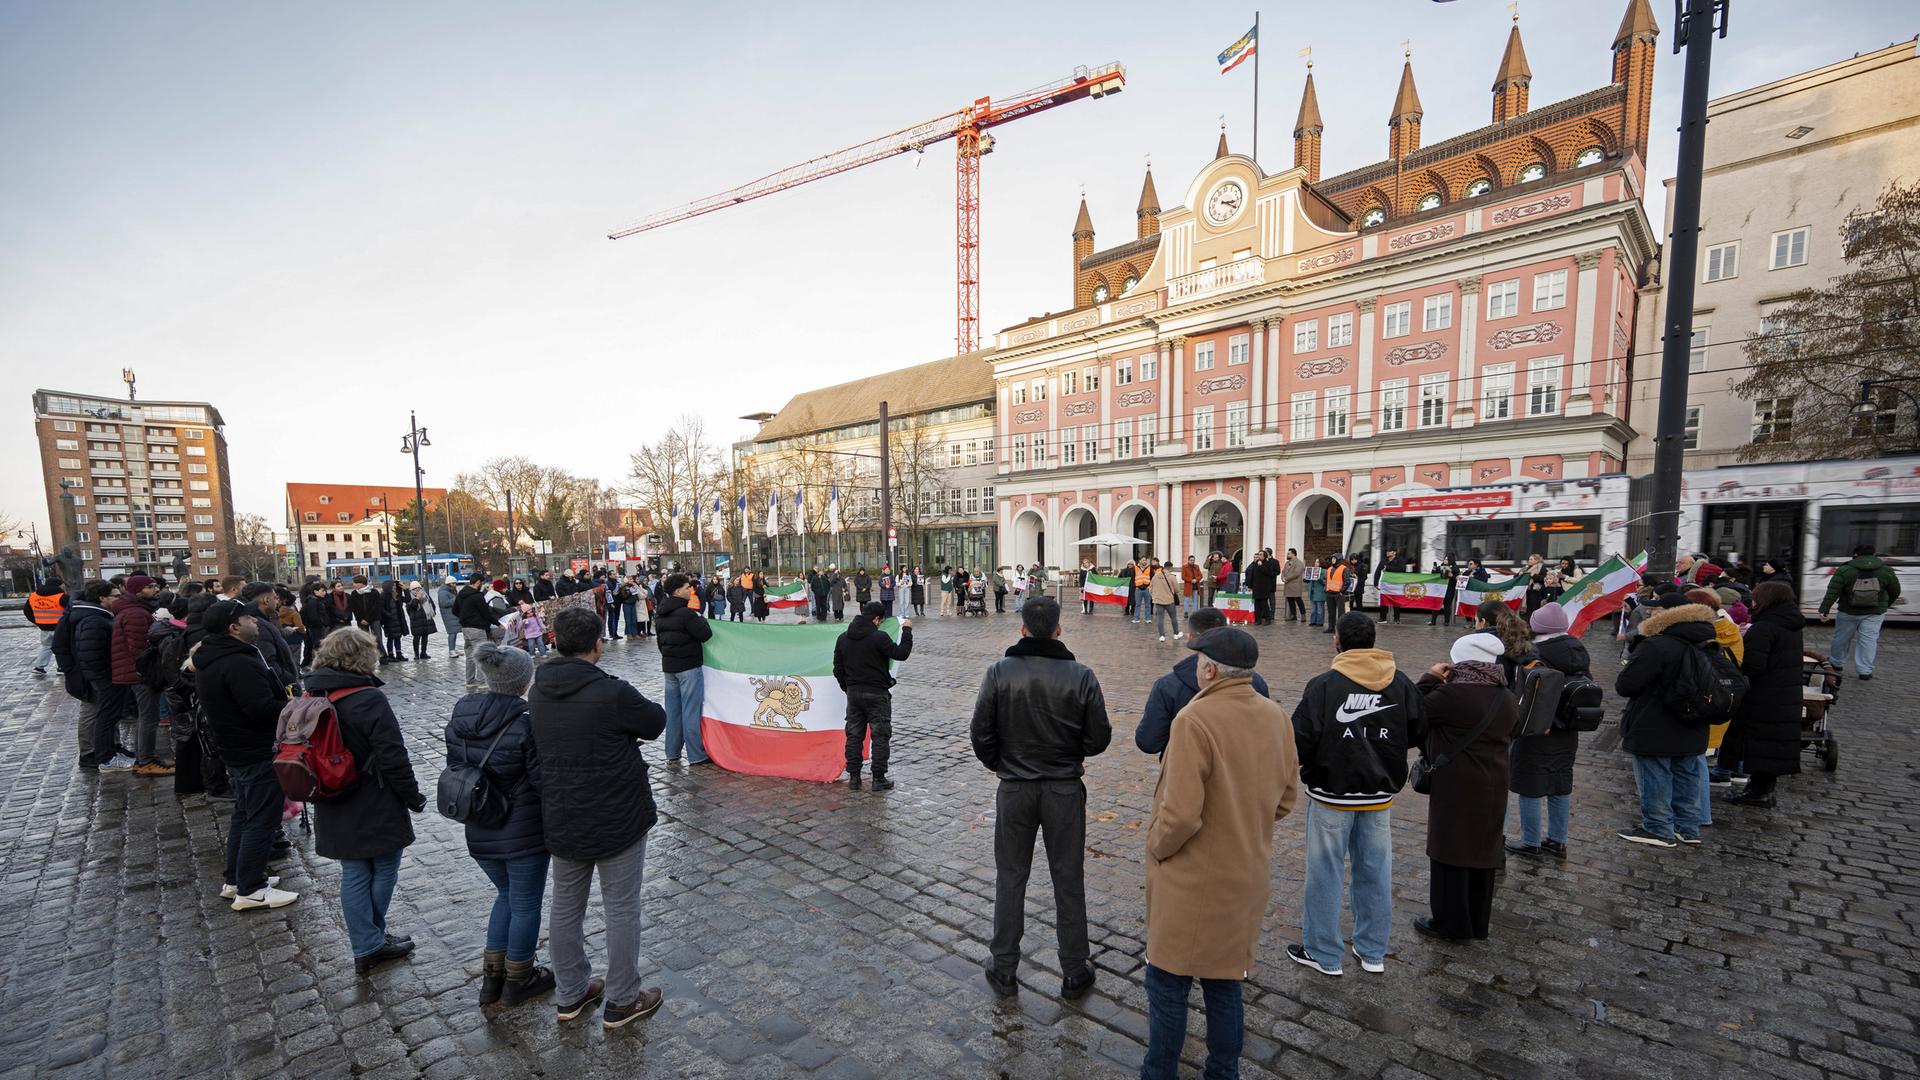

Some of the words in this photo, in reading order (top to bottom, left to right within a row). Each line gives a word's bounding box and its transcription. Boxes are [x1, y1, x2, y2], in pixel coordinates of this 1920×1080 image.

[1197, 527, 1241, 535] RATHAUS
[1344, 693, 1382, 710] NIKE
[1342, 727, 1389, 739] AIR
